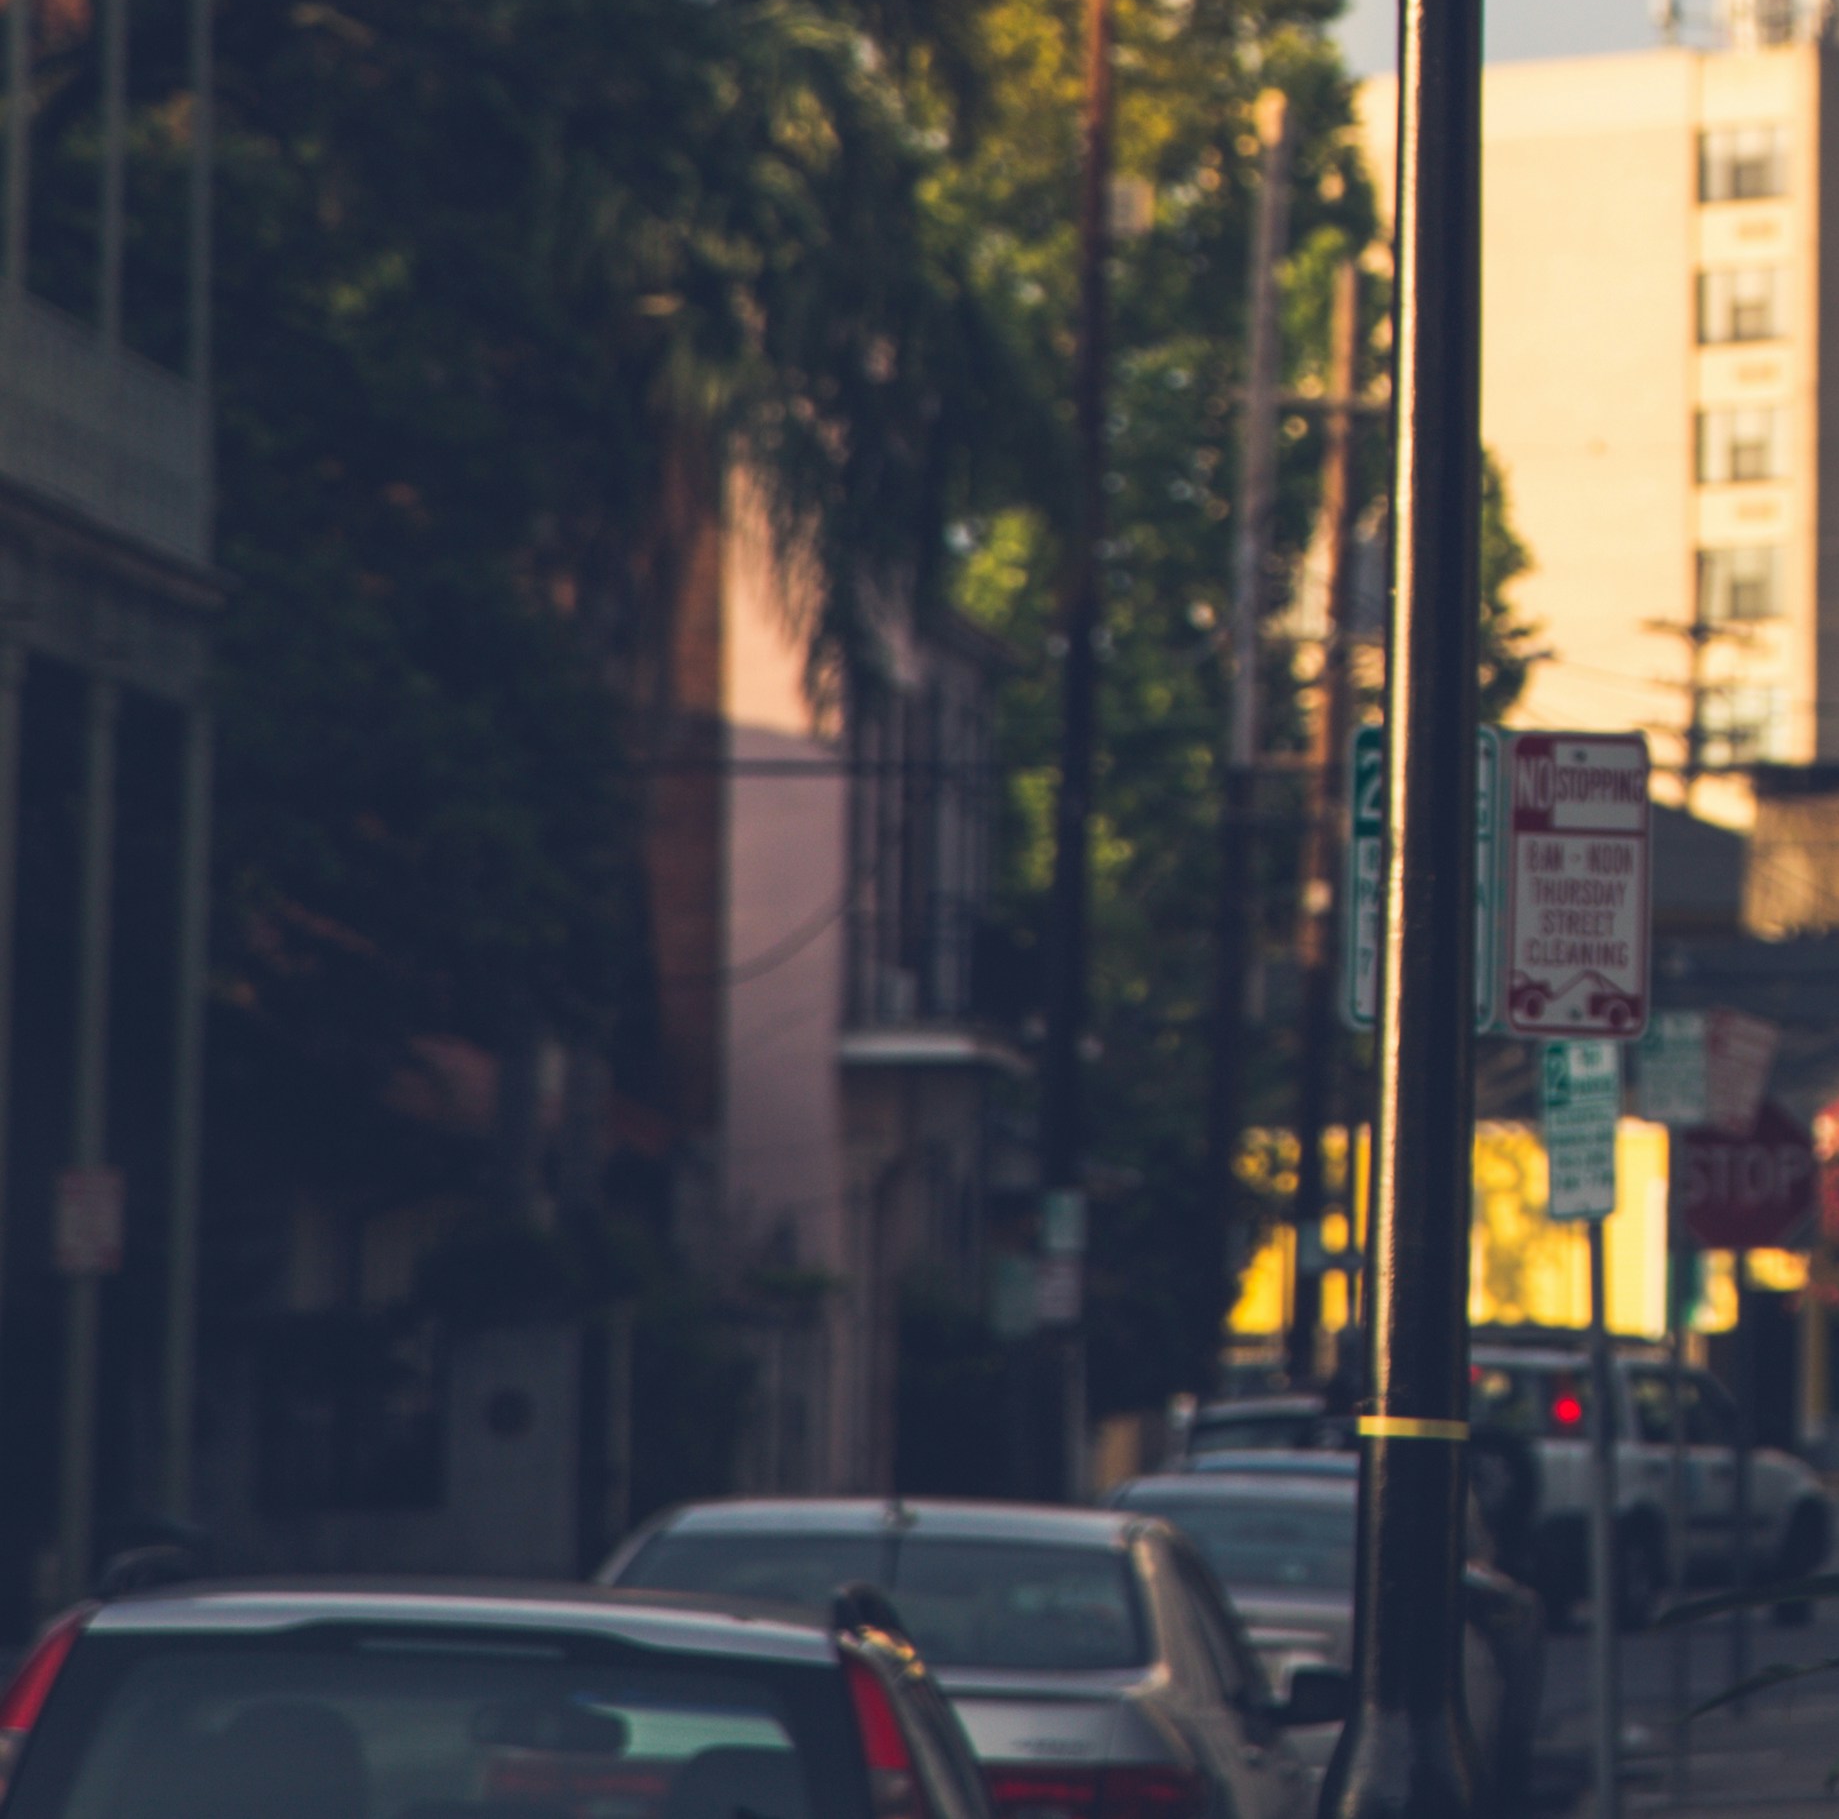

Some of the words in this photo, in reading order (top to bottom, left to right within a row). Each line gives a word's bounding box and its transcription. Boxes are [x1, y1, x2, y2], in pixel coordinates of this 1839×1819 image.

[1518, 757, 1554, 810] NO
[1557, 766, 1642, 802] STOPPING
[1590, 845, 1632, 873] NOON
[1531, 879, 1626, 907] THURSDAY
[1542, 910, 1614, 936] STREET
[1525, 940, 1628, 967] CLEANING
[1685, 1145, 1809, 1200] STOP
